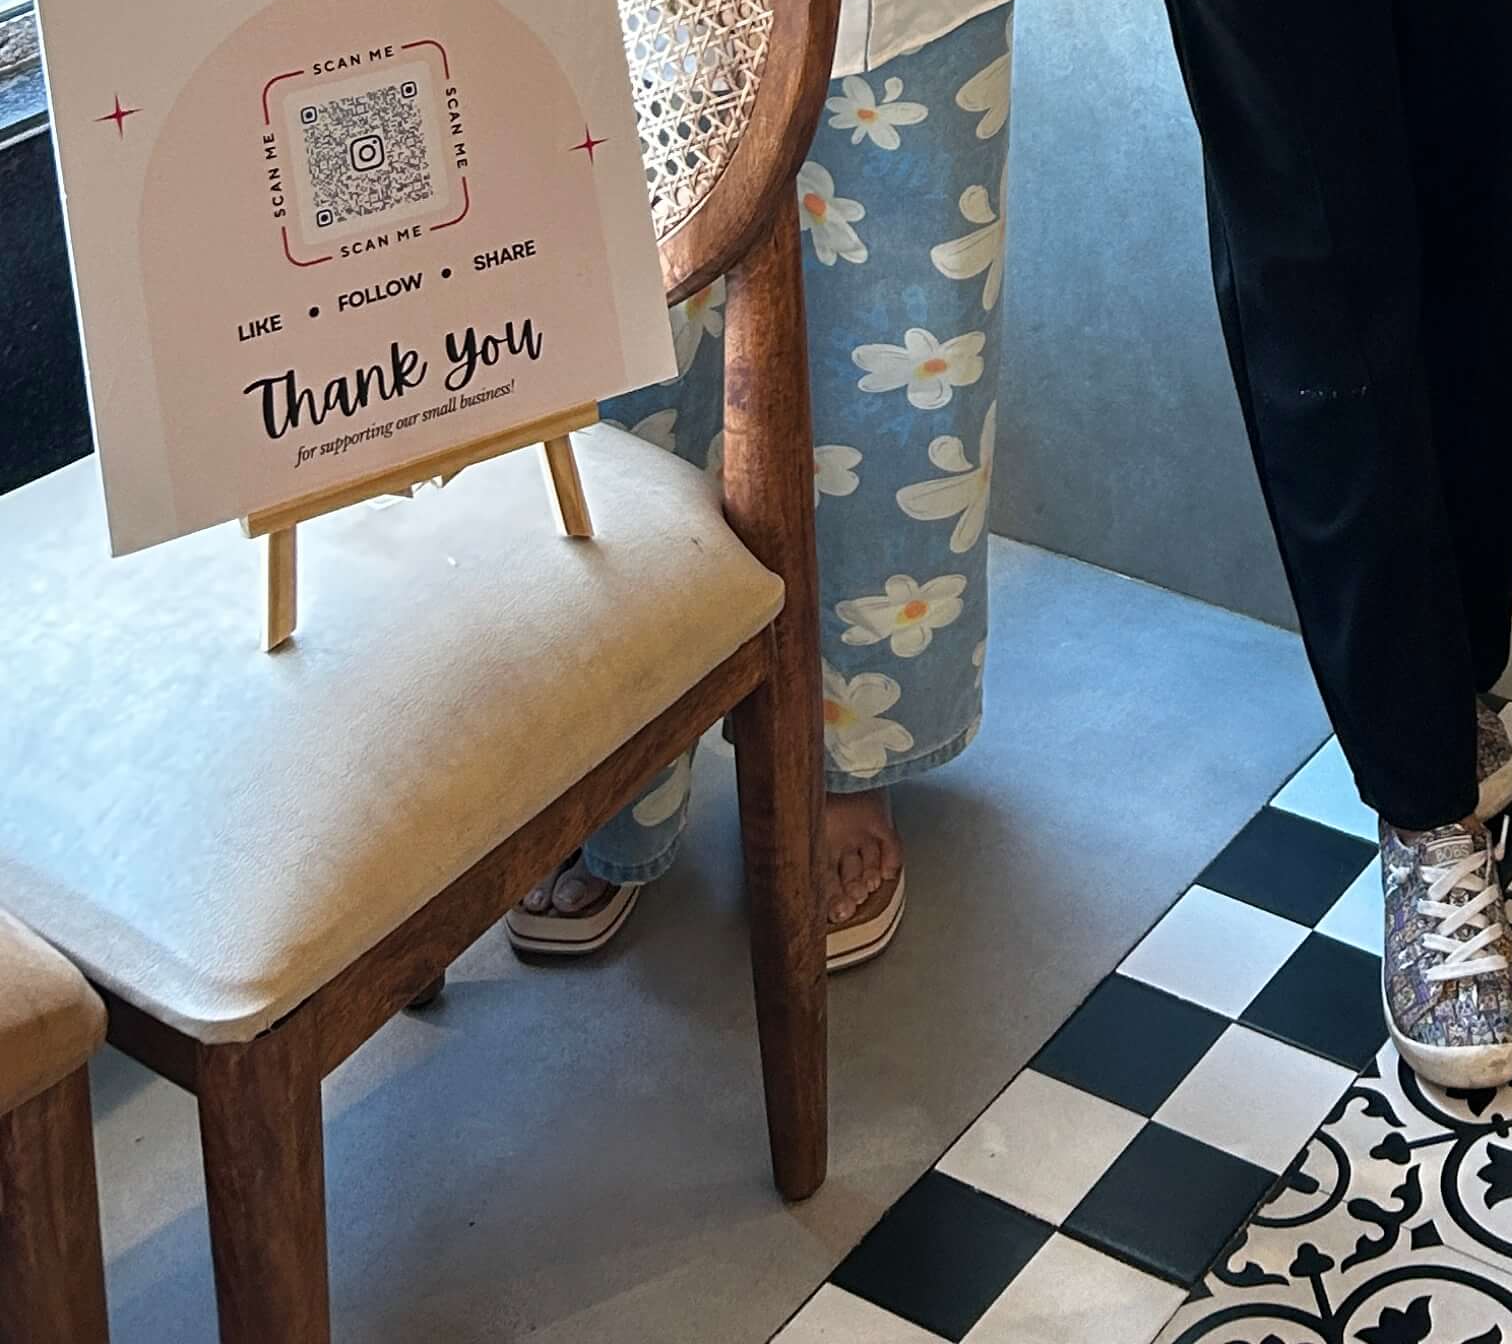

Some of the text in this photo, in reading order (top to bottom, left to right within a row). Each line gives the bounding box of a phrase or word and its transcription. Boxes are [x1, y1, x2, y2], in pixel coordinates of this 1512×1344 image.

[312, 45, 395, 75] SCAN ME
[445, 86, 469, 169] SCAN ME
[262, 132, 287, 219] SCAN ME
[340, 225, 423, 258] SCAN ME
[237, 239, 538, 342] LIKE FOLLOW SHARE
[243, 318, 544, 439] Thank You
[294, 378, 516, 469] for supporting our small business!
